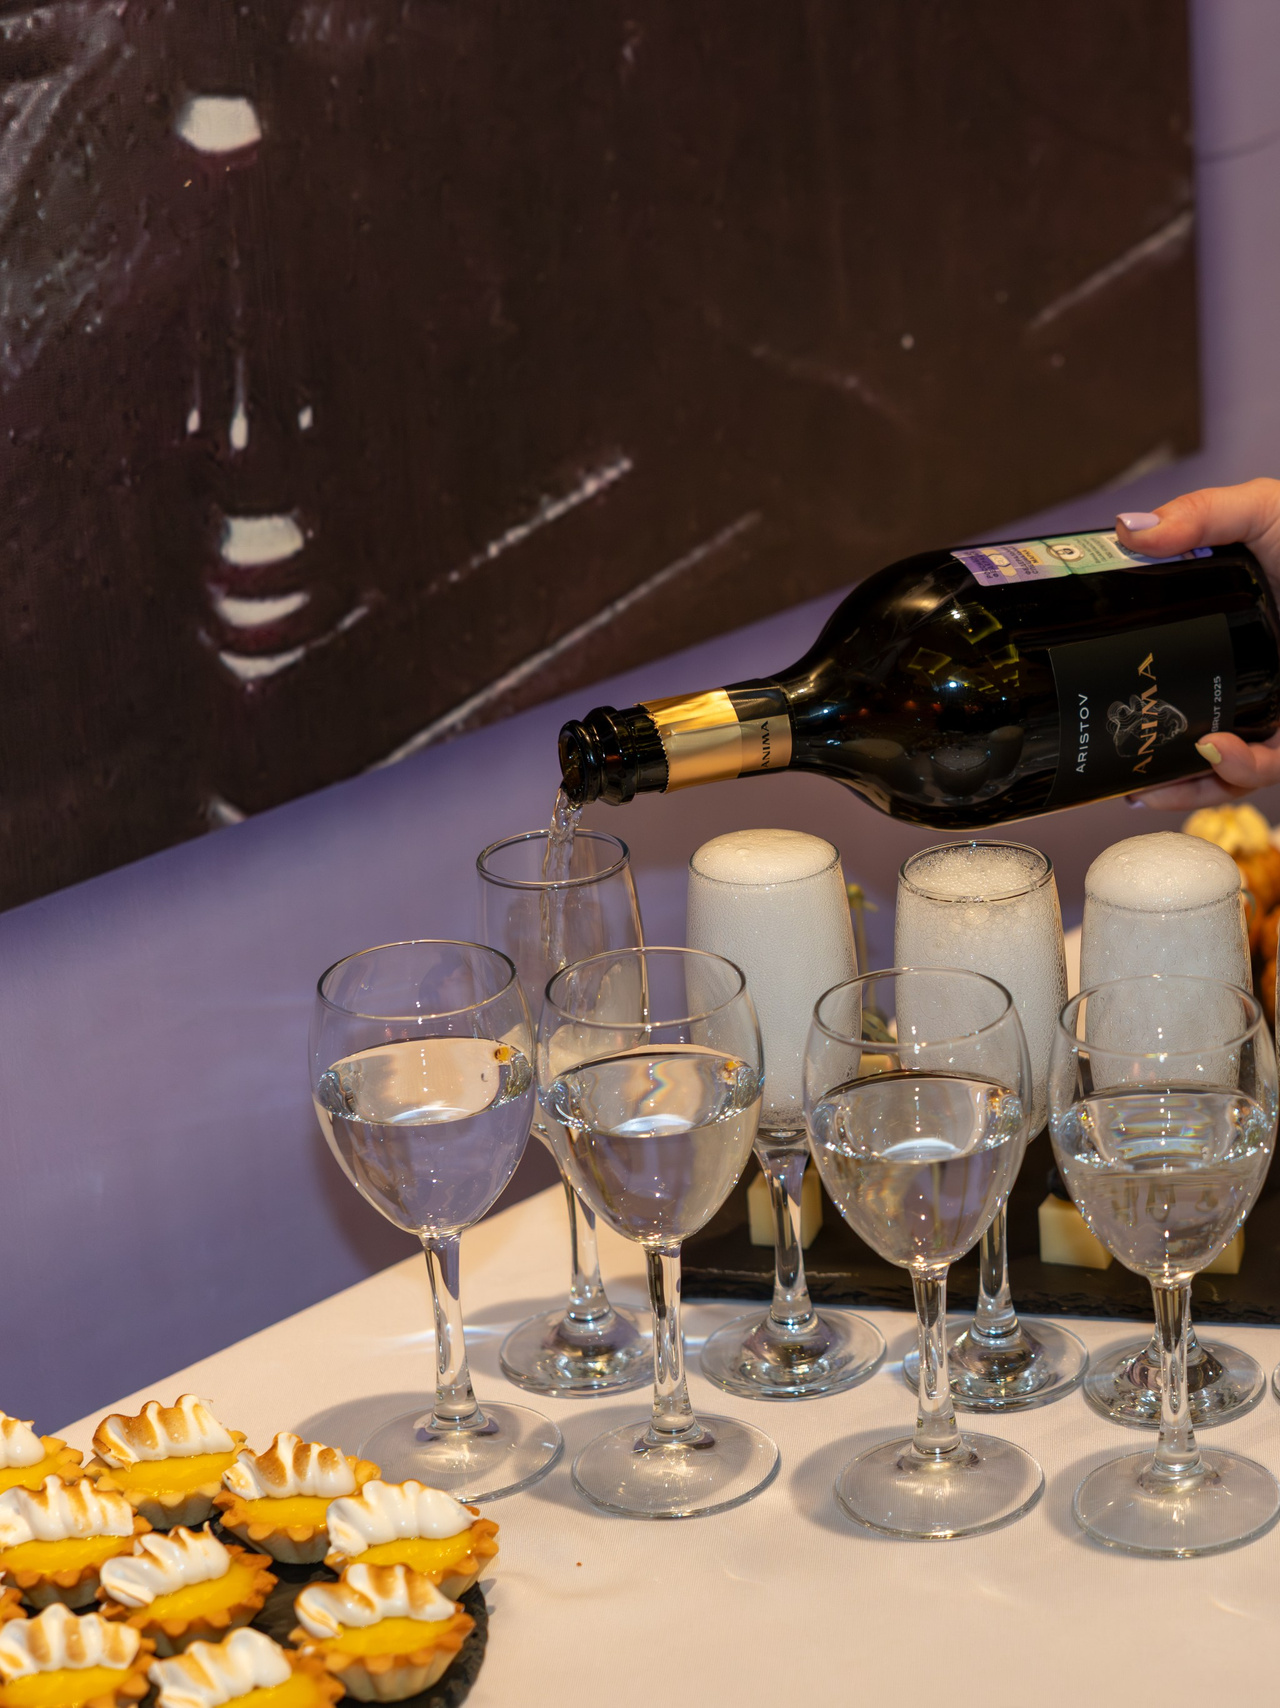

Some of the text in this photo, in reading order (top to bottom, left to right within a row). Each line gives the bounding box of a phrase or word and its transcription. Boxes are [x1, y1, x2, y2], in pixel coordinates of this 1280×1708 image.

[1132, 652, 1158, 774] ANIMA
[1213, 675, 1222, 703] 2025
[761, 720, 770, 768] ANIMA
[1075, 693, 1090, 773] ARISTOV
